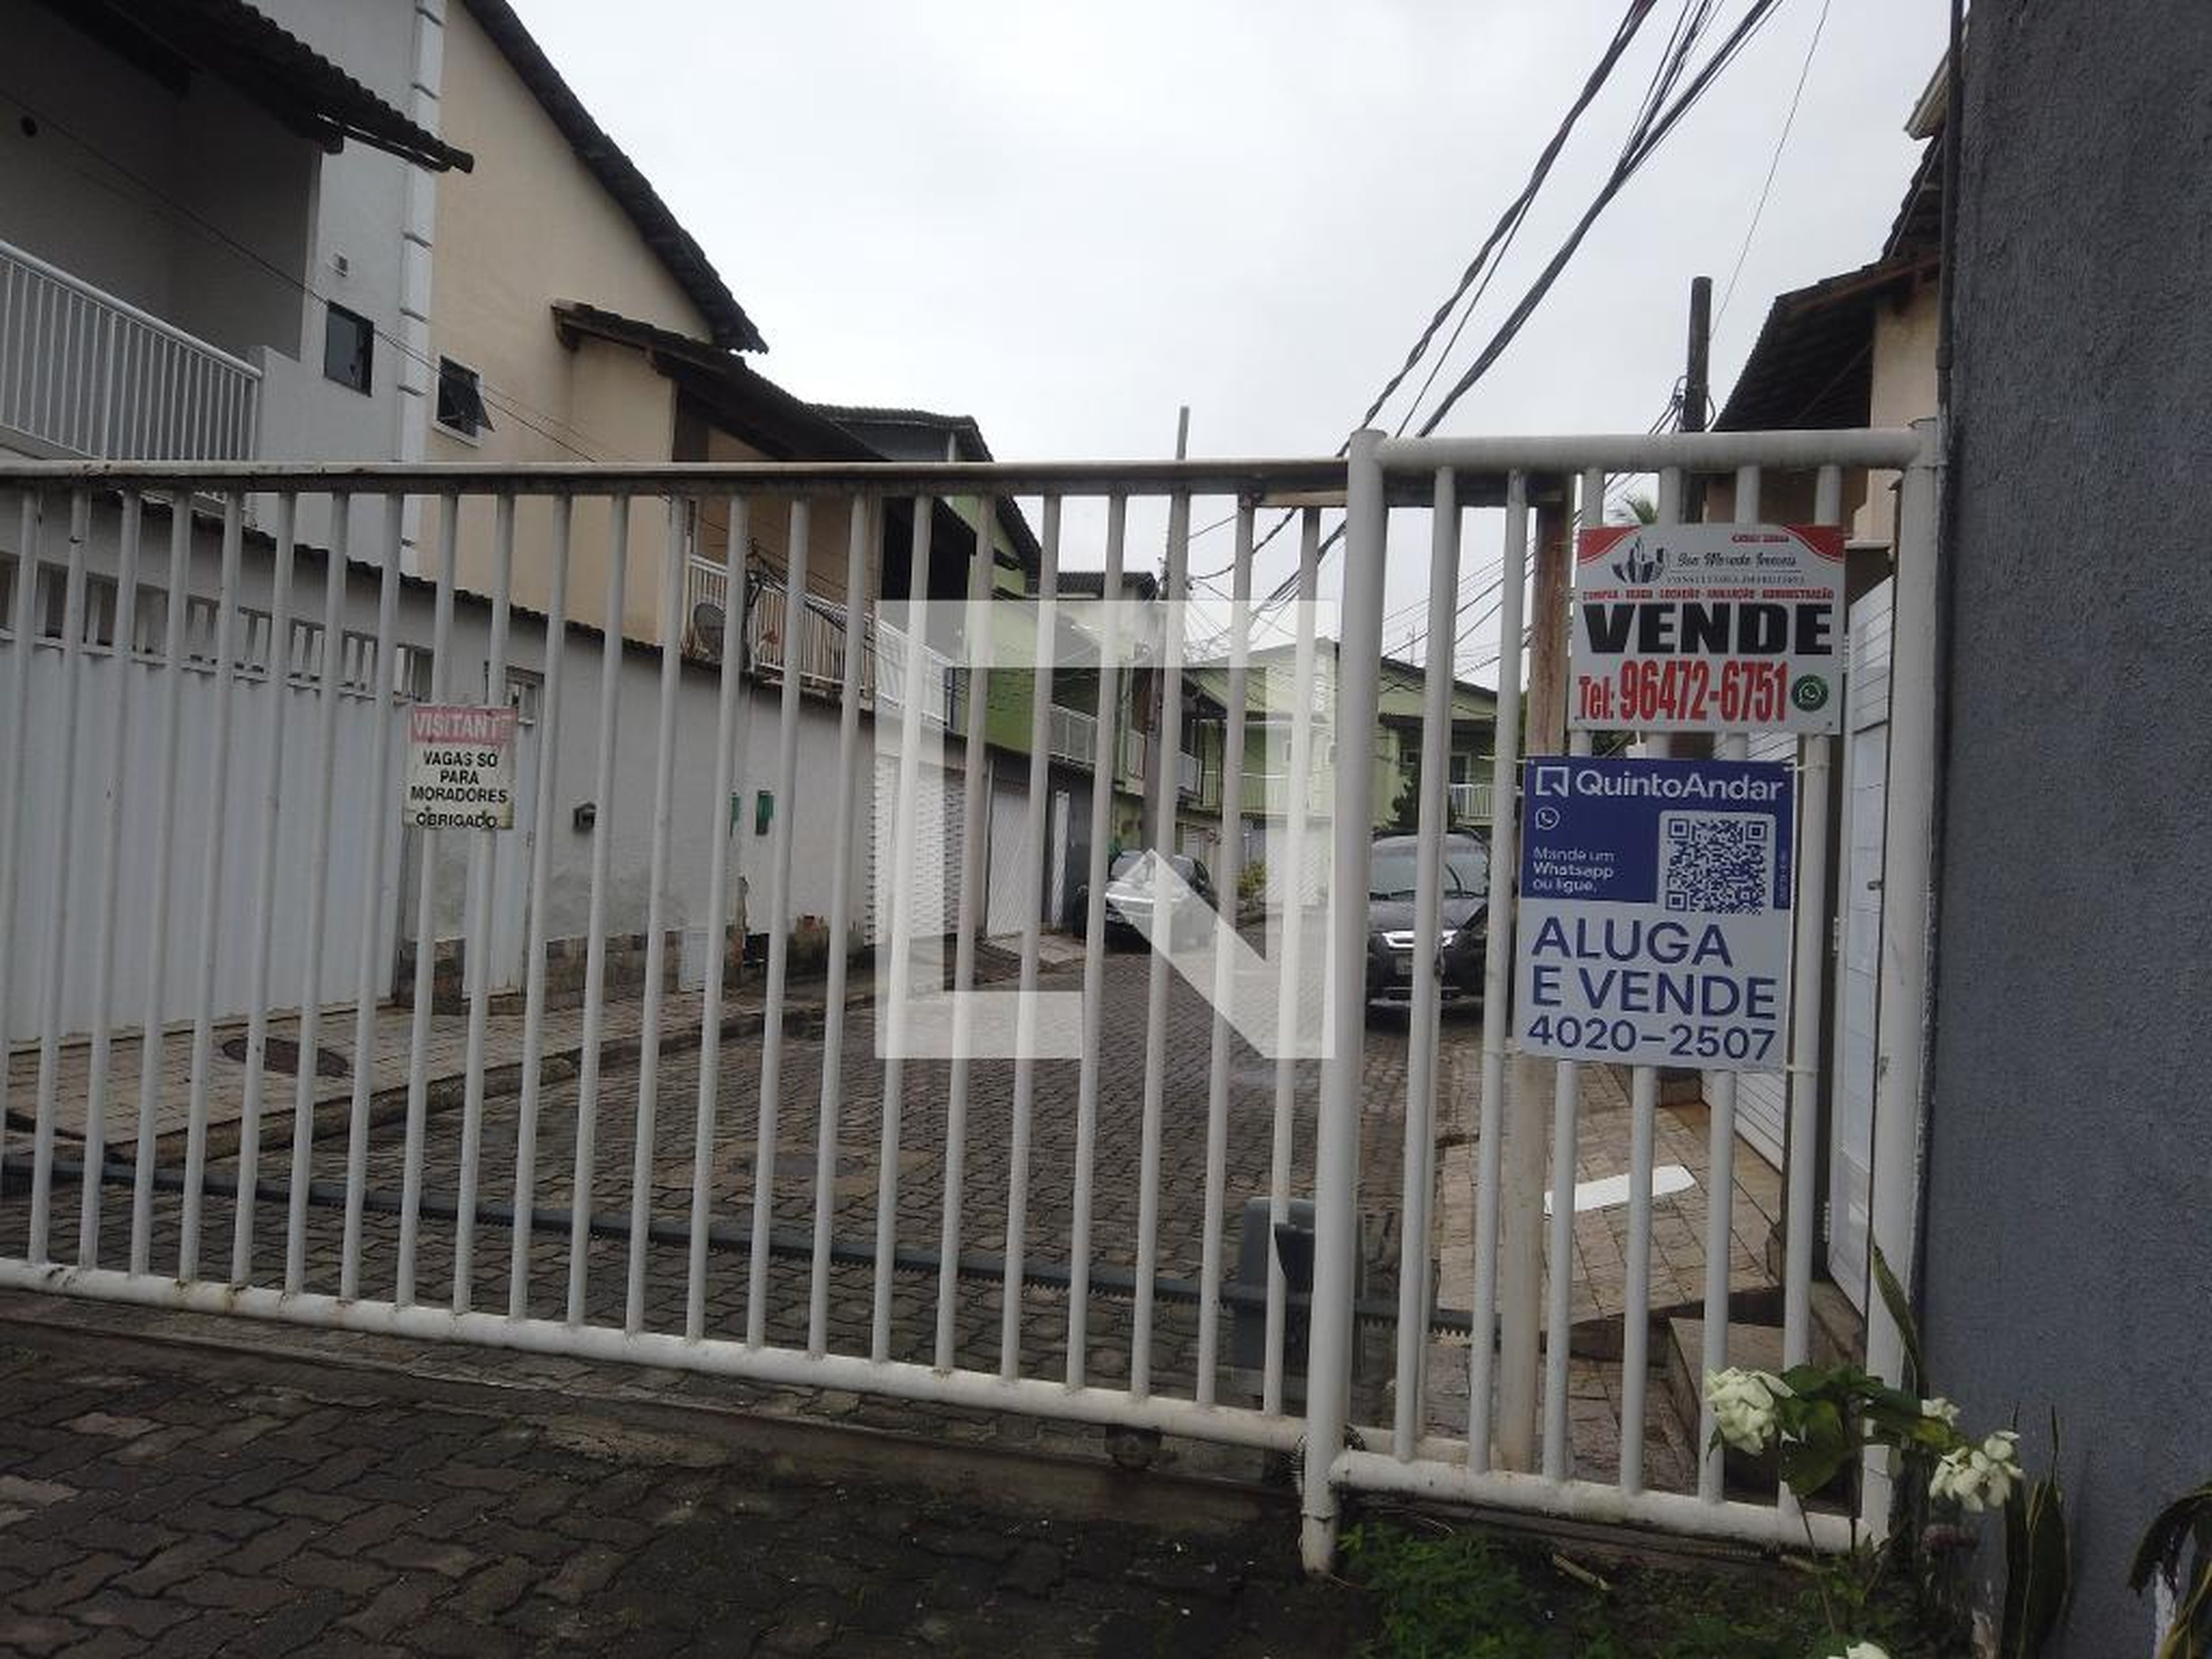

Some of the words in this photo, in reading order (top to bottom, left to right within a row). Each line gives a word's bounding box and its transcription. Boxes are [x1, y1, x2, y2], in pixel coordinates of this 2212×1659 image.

[1583, 603, 1832, 655] VENDE
[1578, 676, 1614, 720] Tel:
[1619, 660, 1788, 724] 96472-6751
[423, 751, 472, 767] VAGAS
[440, 770, 479, 785] PARA
[1575, 770, 1783, 801] QuintoAndar
[410, 786, 507, 803] MORADORES
[416, 812, 497, 828] OBRIGADO
[1533, 846, 1586, 861] Mande
[1532, 861, 1614, 880] Whatsapp
[1532, 878, 1552, 891] ou
[1531, 916, 1733, 968] ALUGA
[1533, 965, 1562, 1007] E
[1578, 968, 1777, 1021] VENDE
